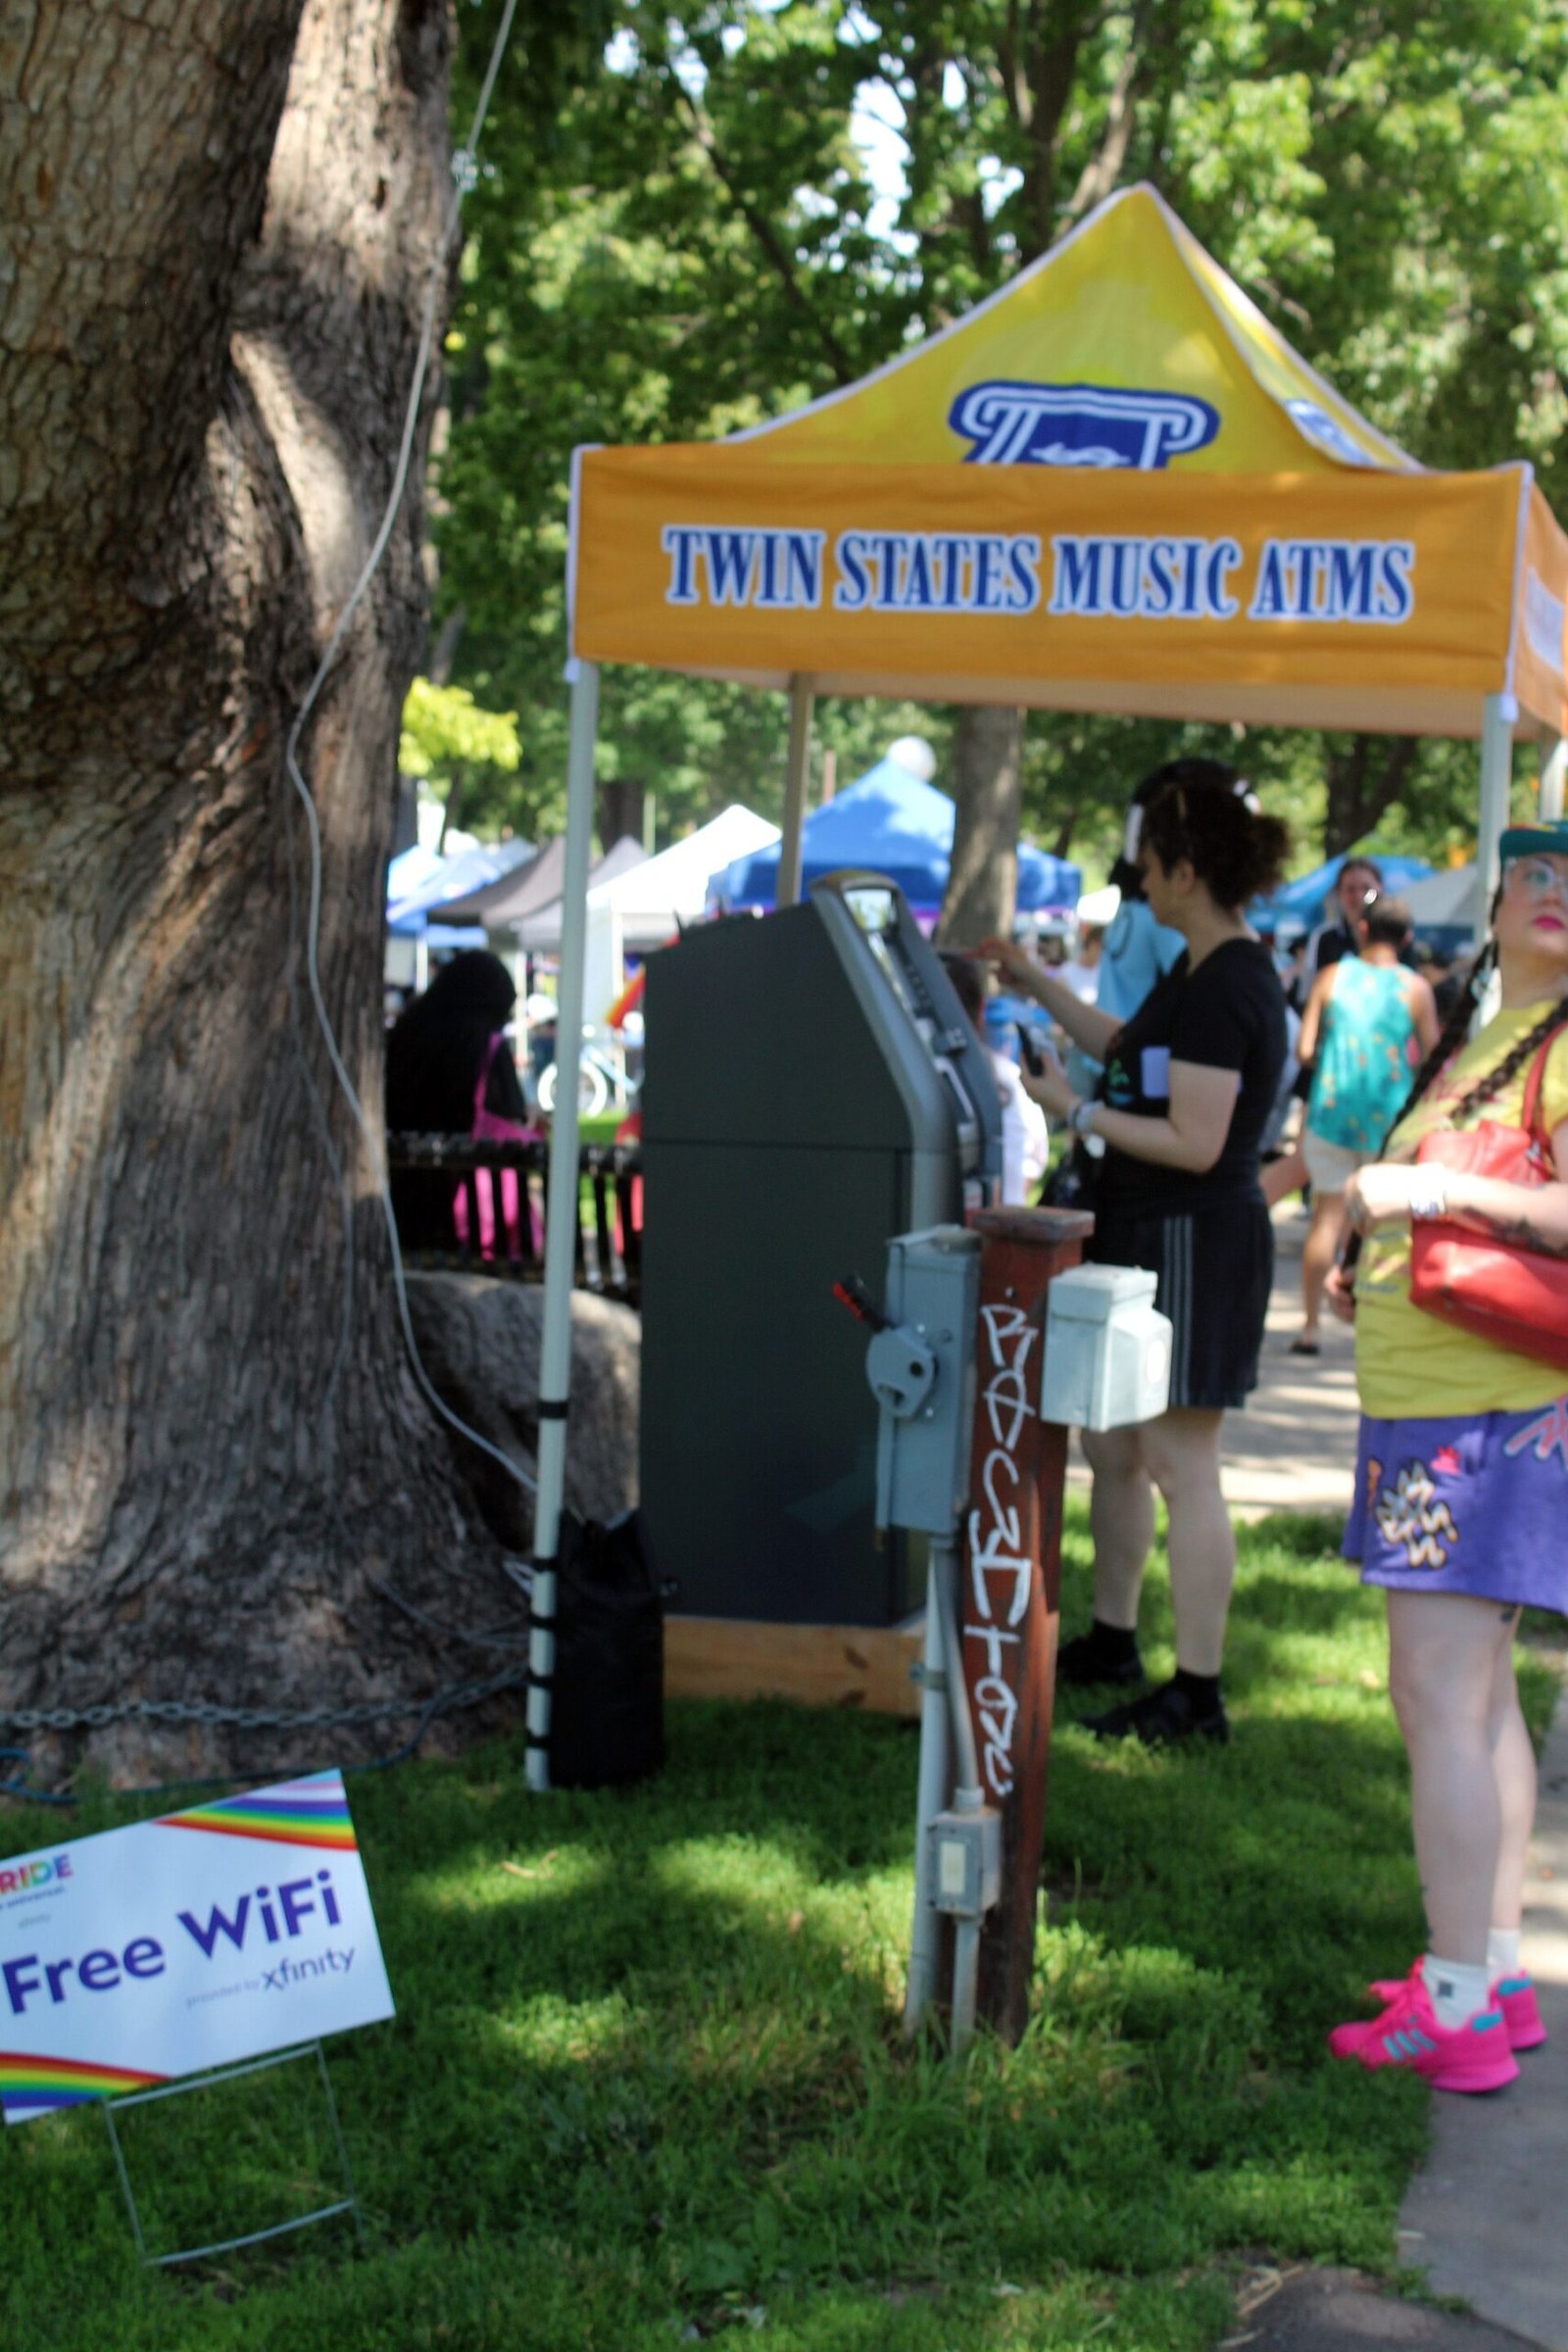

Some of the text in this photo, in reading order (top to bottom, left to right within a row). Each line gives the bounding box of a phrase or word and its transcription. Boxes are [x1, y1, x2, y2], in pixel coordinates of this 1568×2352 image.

[663, 526, 1415, 624] TWIN STATES MUSIC ATMS
[1, 1869, 341, 2015] Free WiFi
[262, 1946, 356, 1991] xfinity
